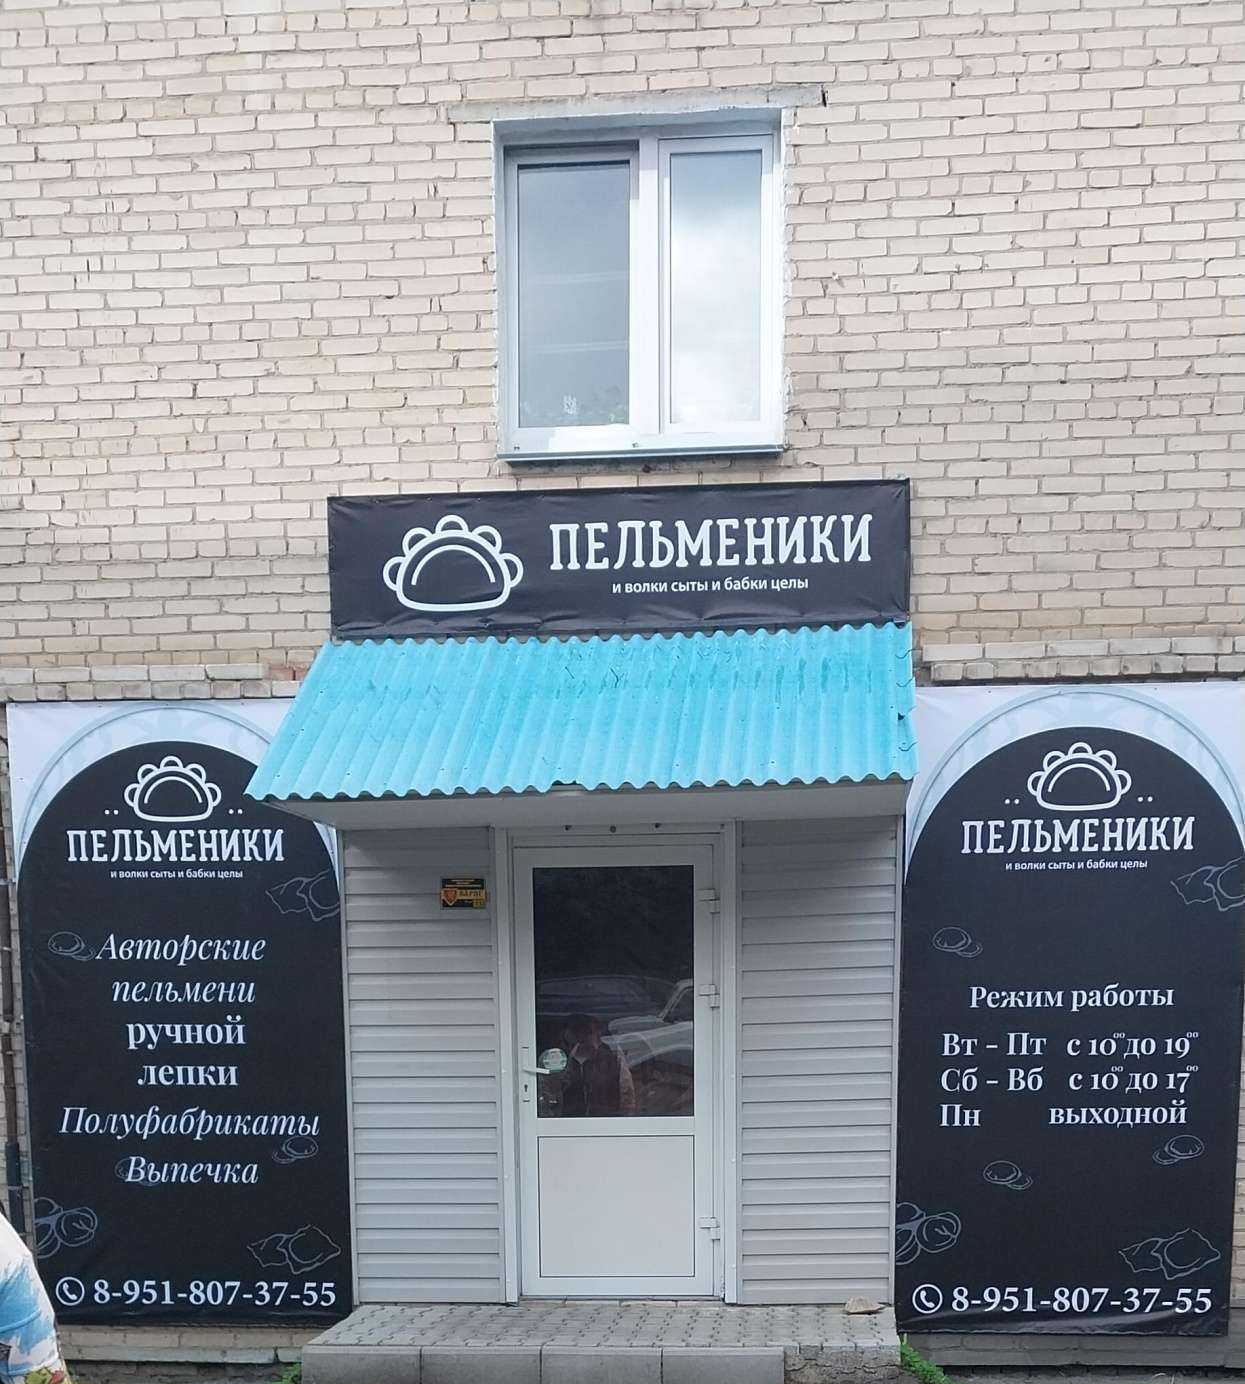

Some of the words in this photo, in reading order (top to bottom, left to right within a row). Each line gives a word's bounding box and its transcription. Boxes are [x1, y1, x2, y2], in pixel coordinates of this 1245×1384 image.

[549, 513, 873, 571] ПЕЛЬМЕНИКИ
[612, 583, 622, 594] и
[625, 581, 668, 593] волки
[671, 580, 709, 592] сыты
[712, 580, 721, 591] и
[724, 576, 768, 590] бабки
[771, 577, 809, 592] целы
[66, 828, 285, 862] ПЕЛЬМЕНИКИ
[961, 816, 1196, 854] ПЕЛЬМЕНИКИ
[110, 870, 117, 879] и
[119, 870, 149, 879] волки
[150, 870, 176, 879] сыты
[178, 870, 184, 879] и
[186, 868, 216, 879] бабки
[218, 870, 243, 880] целы
[1005, 862, 1013, 871] и
[1015, 861, 1046, 871] волки
[1048, 861, 1075, 870] сыты
[1078, 860, 1085, 869] и
[1086, 859, 1118, 869] бабки
[1120, 859, 1148, 870] целы
[95, 933, 267, 966] Авторские
[112, 981, 256, 1003] пельмени
[969, 986, 1063, 1008] Режим
[1071, 983, 1175, 1012] работы
[126, 1014, 247, 1050] ручной
[942, 1033, 978, 1056] Вт
[1006, 1032, 1047, 1056] Пт
[1066, 1038, 1081, 1056] с
[1123, 1037, 1156, 1060] до
[137, 1064, 239, 1086] лепки
[941, 1066, 978, 1092] Сб
[1007, 1066, 1044, 1091] Вб
[1069, 1073, 1083, 1091] с
[1125, 1072, 1158, 1094] до
[58, 1105, 320, 1140] Полуфабрикаты
[939, 1104, 982, 1127] Пн
[1049, 1100, 1188, 1128] выходной
[126, 1156, 259, 1184] Выпечка
[93, 1280, 337, 1306] 8-951-807-37-55
[951, 1287, 1212, 1313] 8-951-807-37-55
